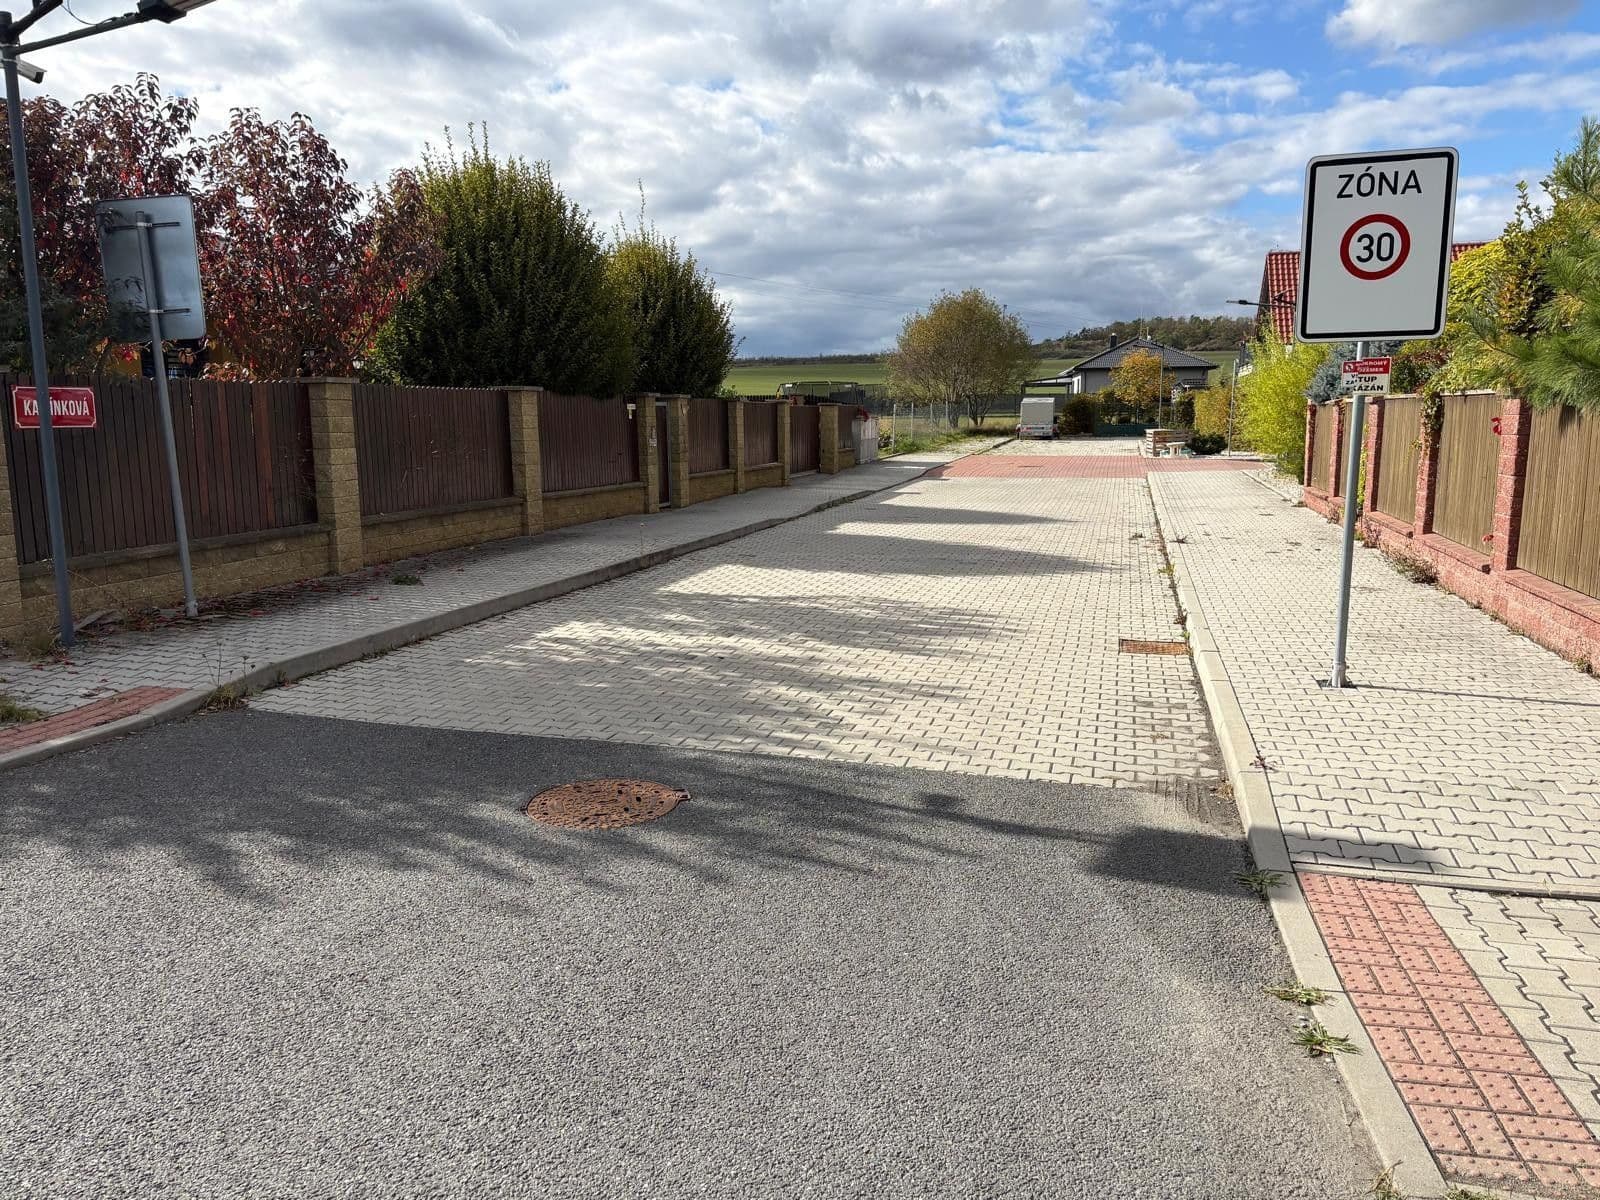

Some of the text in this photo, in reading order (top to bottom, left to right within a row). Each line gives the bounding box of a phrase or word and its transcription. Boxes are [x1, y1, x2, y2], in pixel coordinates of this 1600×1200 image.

[1336, 165, 1423, 199] ZÓNA
[1355, 232, 1395, 263] 30
[23, 396, 90, 416] KAÍNKOVÁ
